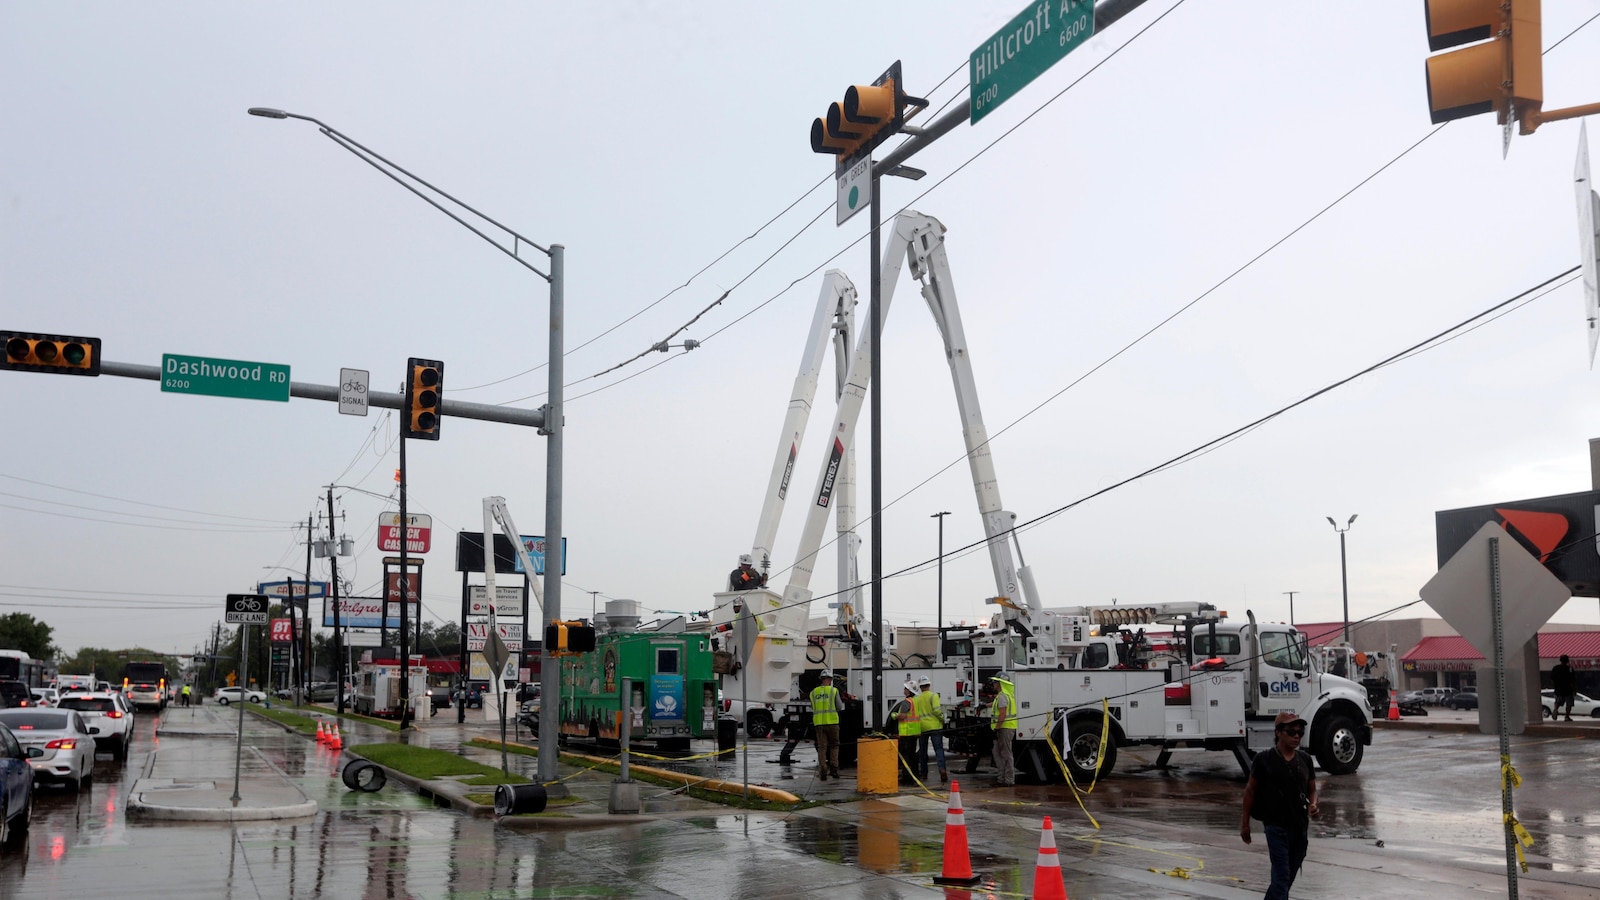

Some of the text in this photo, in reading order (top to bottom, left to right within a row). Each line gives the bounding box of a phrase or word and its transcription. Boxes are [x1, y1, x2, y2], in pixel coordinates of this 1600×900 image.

[1059, 14, 1087, 47] 6600
[975, 0, 1050, 85] Hillcroft
[976, 83, 998, 110] 6700
[840, 160, 868, 190] ON GREEN
[166, 357, 286, 384] Dashwood RD
[165, 379, 190, 389] 6200
[341, 396, 366, 406] SIGNAL
[822, 459, 838, 494] TEREX
[389, 527, 421, 539] CHCK
[331, 600, 383, 617] Walgree
[227, 613, 266, 622] BIKE LANE
[273, 621, 291, 633] BT
[469, 624, 508, 638] NAS
[468, 642, 483, 650] 713
[1270, 681, 1300, 693] GMB
[815, 693, 829, 701] GMB
